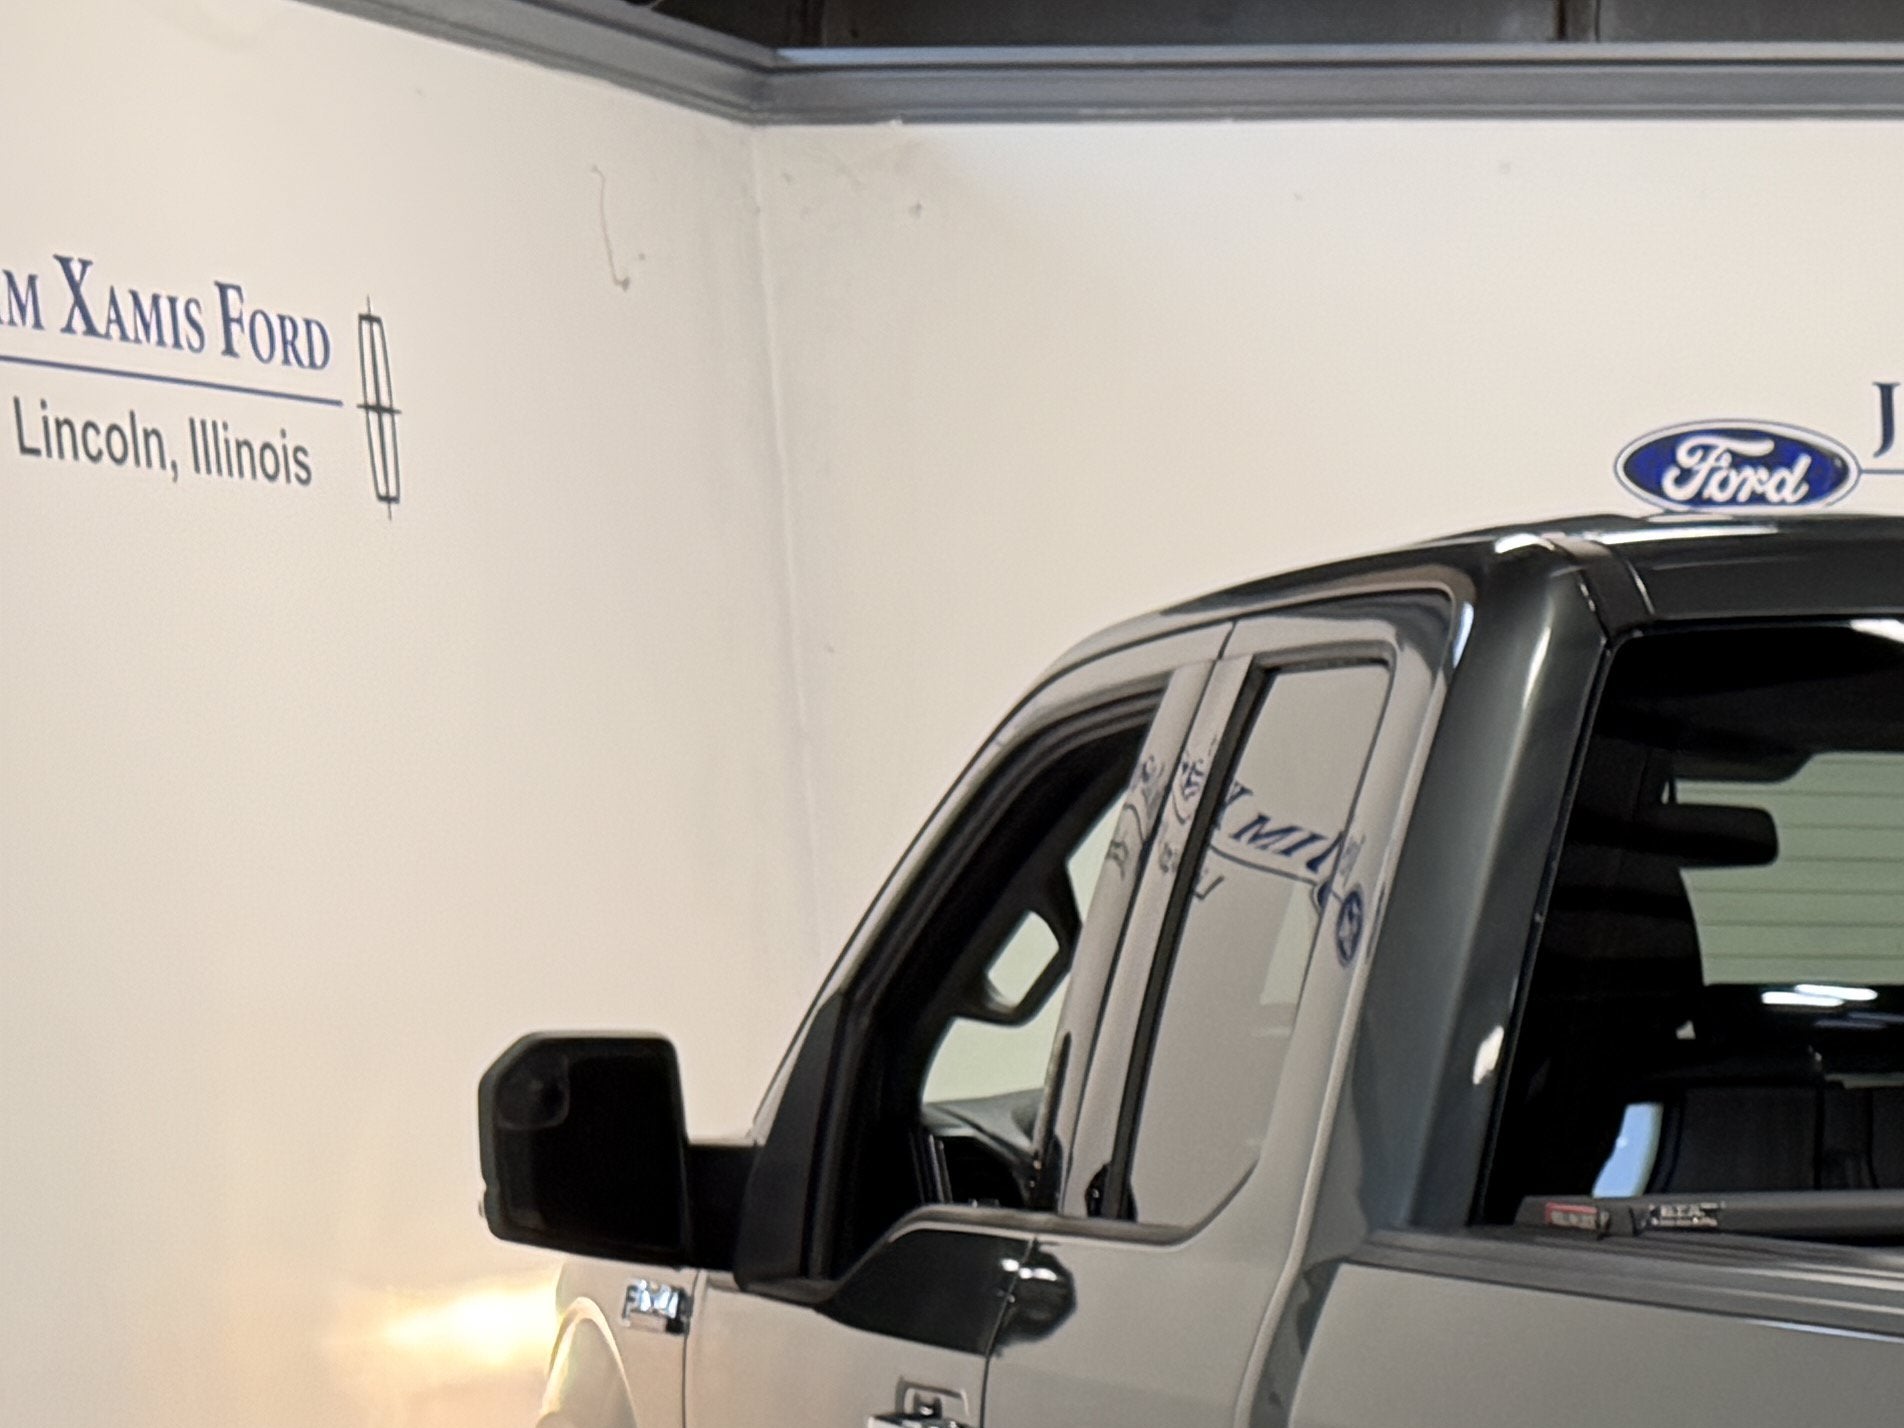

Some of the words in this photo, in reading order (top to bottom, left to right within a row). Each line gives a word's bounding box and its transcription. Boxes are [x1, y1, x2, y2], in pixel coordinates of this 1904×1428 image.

[53, 253, 206, 353] XAMIS
[214, 280, 331, 370] FORD
[13, 395, 179, 483] Lincoln,
[188, 417, 313, 486] Illinois
[1661, 435, 1812, 504] Ford
